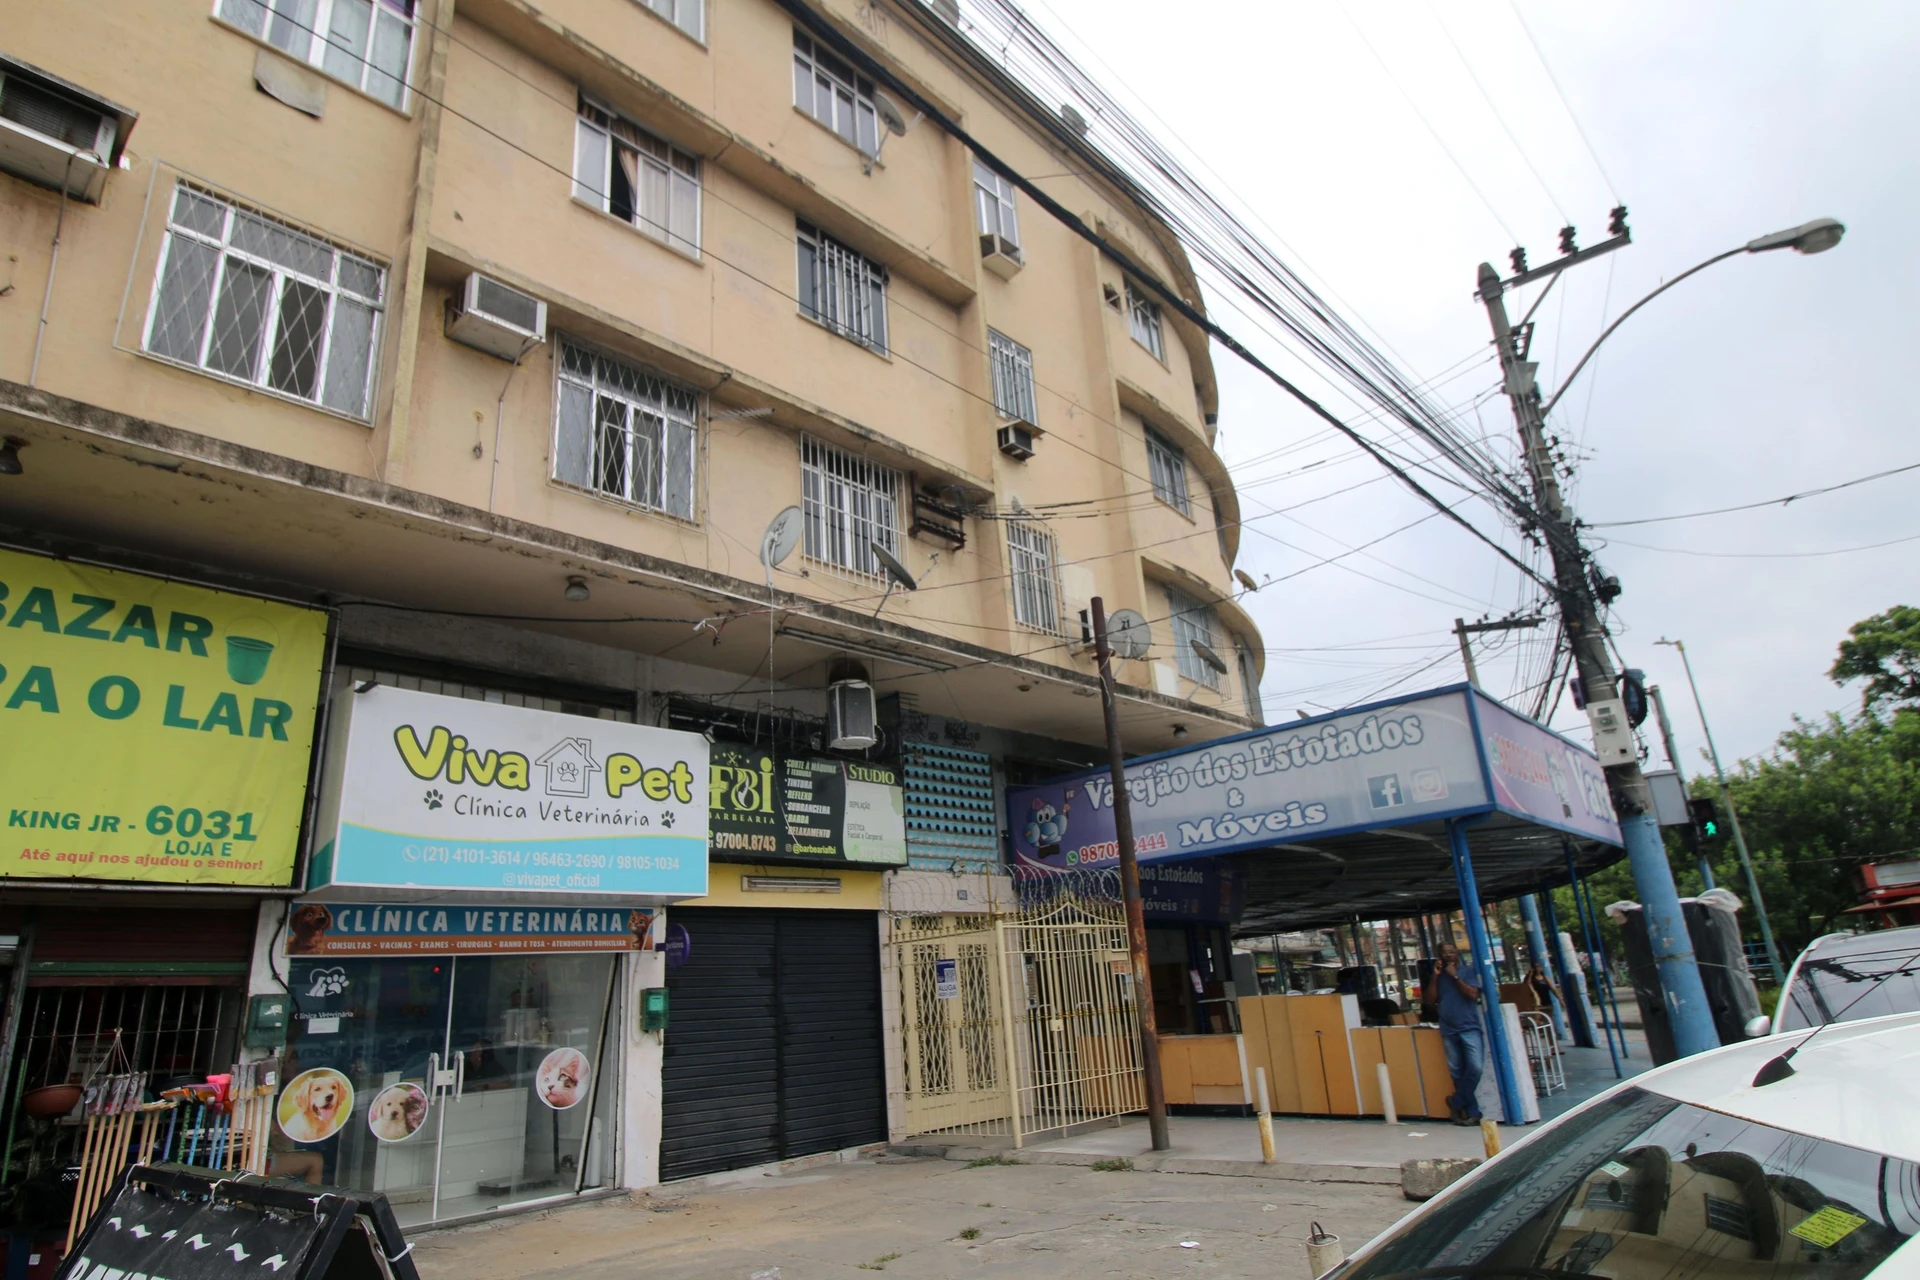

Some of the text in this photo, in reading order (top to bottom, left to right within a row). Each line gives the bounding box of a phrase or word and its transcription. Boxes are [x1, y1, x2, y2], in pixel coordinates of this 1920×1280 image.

[0, 580, 214, 657] AZAR
[87, 675, 141, 720] O
[163, 685, 293, 742] LAR
[1193, 751, 1249, 788] dos
[1251, 713, 1424, 777] Estofados
[393, 724, 693, 804] Viva Pet
[849, 764, 895, 785] STUDIO
[1227, 787, 1245, 808] &
[8, 809, 80, 831] KING
[88, 813, 121, 833] JR
[145, 805, 257, 841] 6031
[454, 794, 650, 827] Clínica Veterinária
[1177, 801, 1327, 848] Móveis
[164, 839, 232, 857] LOJA E
[716, 832, 776, 851] 97004.8743
[19, 847, 264, 871] Até aqui nos ajudou o senhor!
[422, 845, 449, 864] (21)
[452, 846, 521, 866] 4101-3614
[532, 851, 606, 870] 96463-2690
[617, 853, 680, 871] 98105-1034
[517, 872, 600, 890] vivapet_oficial
[1157, 864, 1203, 884] Estofados
[1141, 898, 1178, 911] óveis
[337, 906, 623, 933] CLÍNICA VETERINÁRIA
[327, 941, 372, 950] CONSULTAS
[379, 940, 412, 949] VACINAS
[420, 940, 449, 949] EXAMES
[456, 940, 493, 949] CIRURGIAS
[499, 940, 522, 948] BANHO
[529, 940, 546, 948] TOSA
[551, 940, 593, 948] ATENDIMENTO
[594, 940, 627, 948] DOMICILIAR
